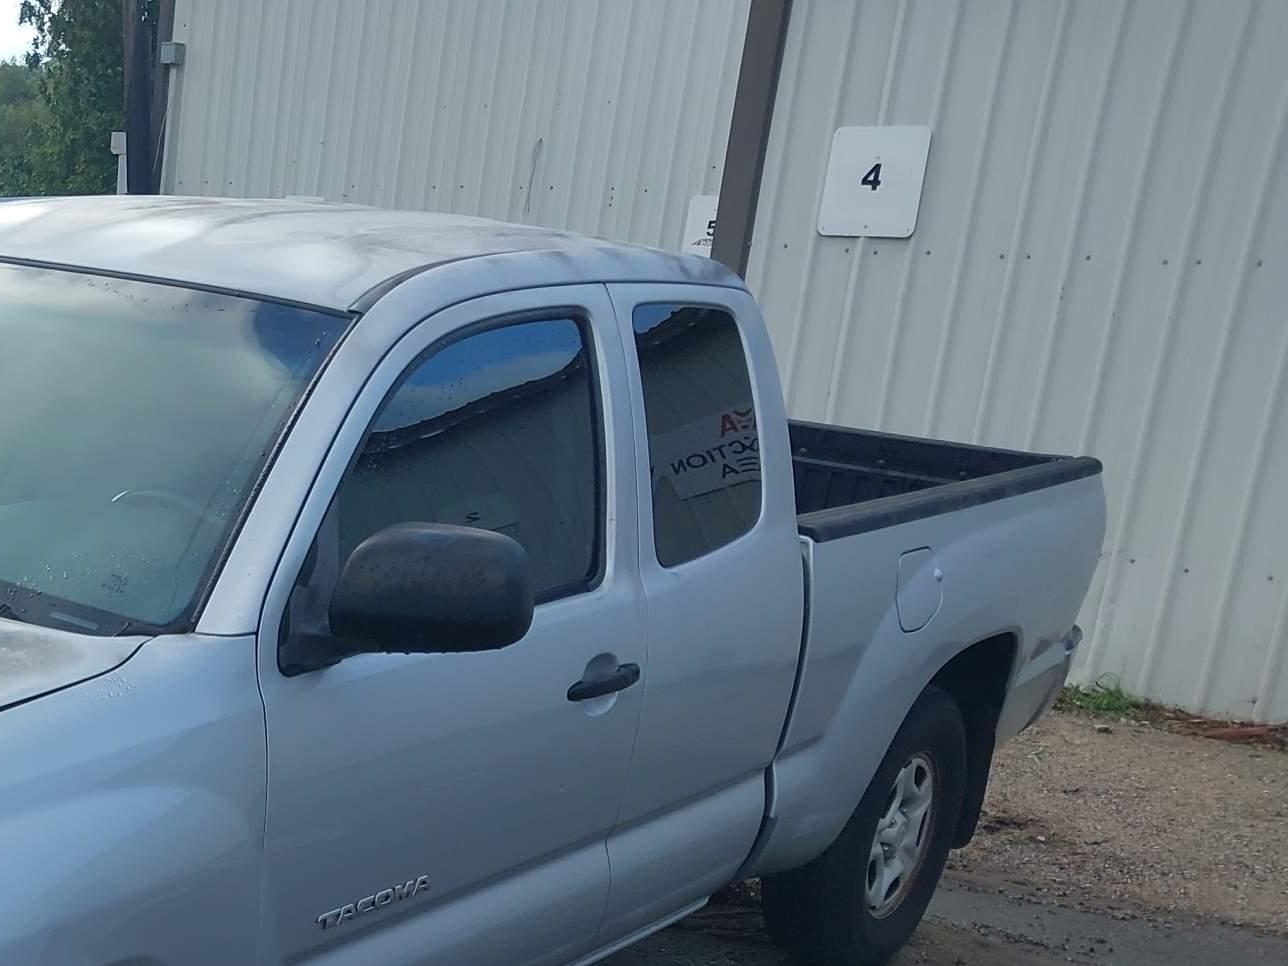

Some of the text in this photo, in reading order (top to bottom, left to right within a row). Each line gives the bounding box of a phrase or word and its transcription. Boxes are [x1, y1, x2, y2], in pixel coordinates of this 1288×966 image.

[861, 163, 882, 191] 4
[706, 220, 717, 237] 5
[316, 874, 429, 929] TACOMA
